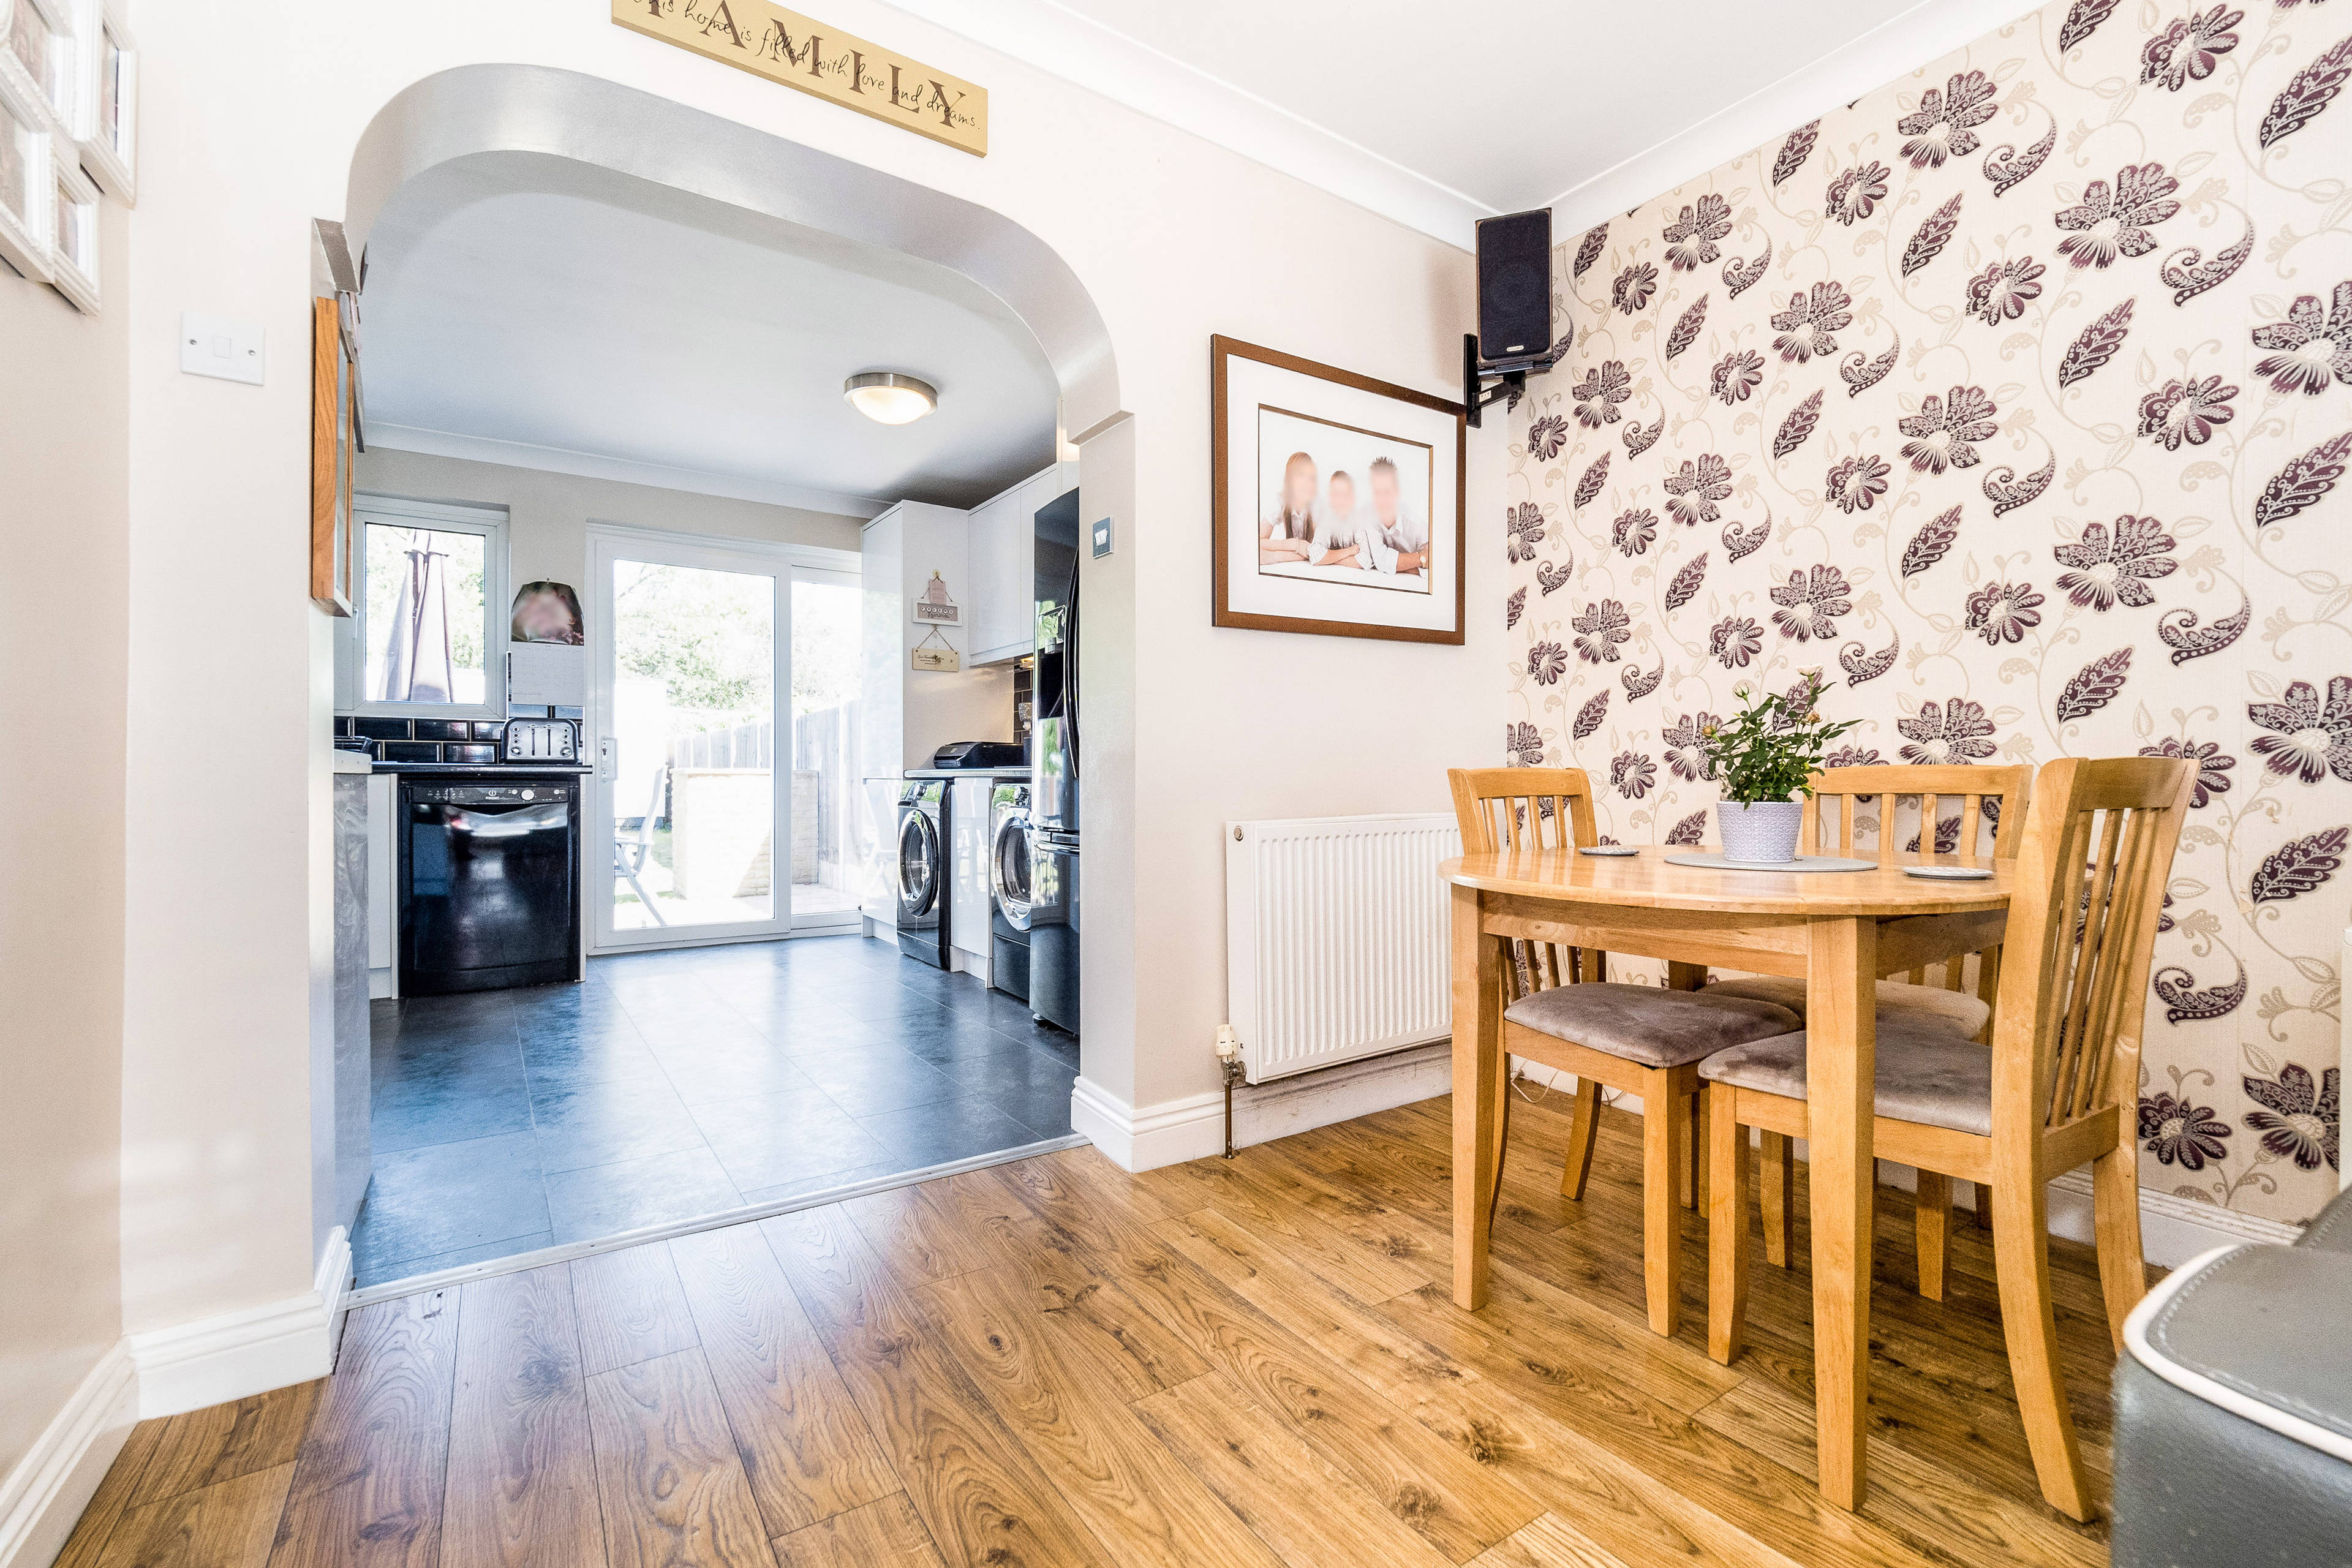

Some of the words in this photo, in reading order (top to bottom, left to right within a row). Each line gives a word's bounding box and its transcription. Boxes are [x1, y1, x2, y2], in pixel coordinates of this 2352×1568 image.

[685, 0, 732, 34] home
[741, 26, 752, 41] is
[755, 28, 810, 64] filled
[814, 54, 849, 77] with
[856, 63, 885, 91] love
[892, 84, 923, 106] and
[926, 90, 981, 130] dreams.
